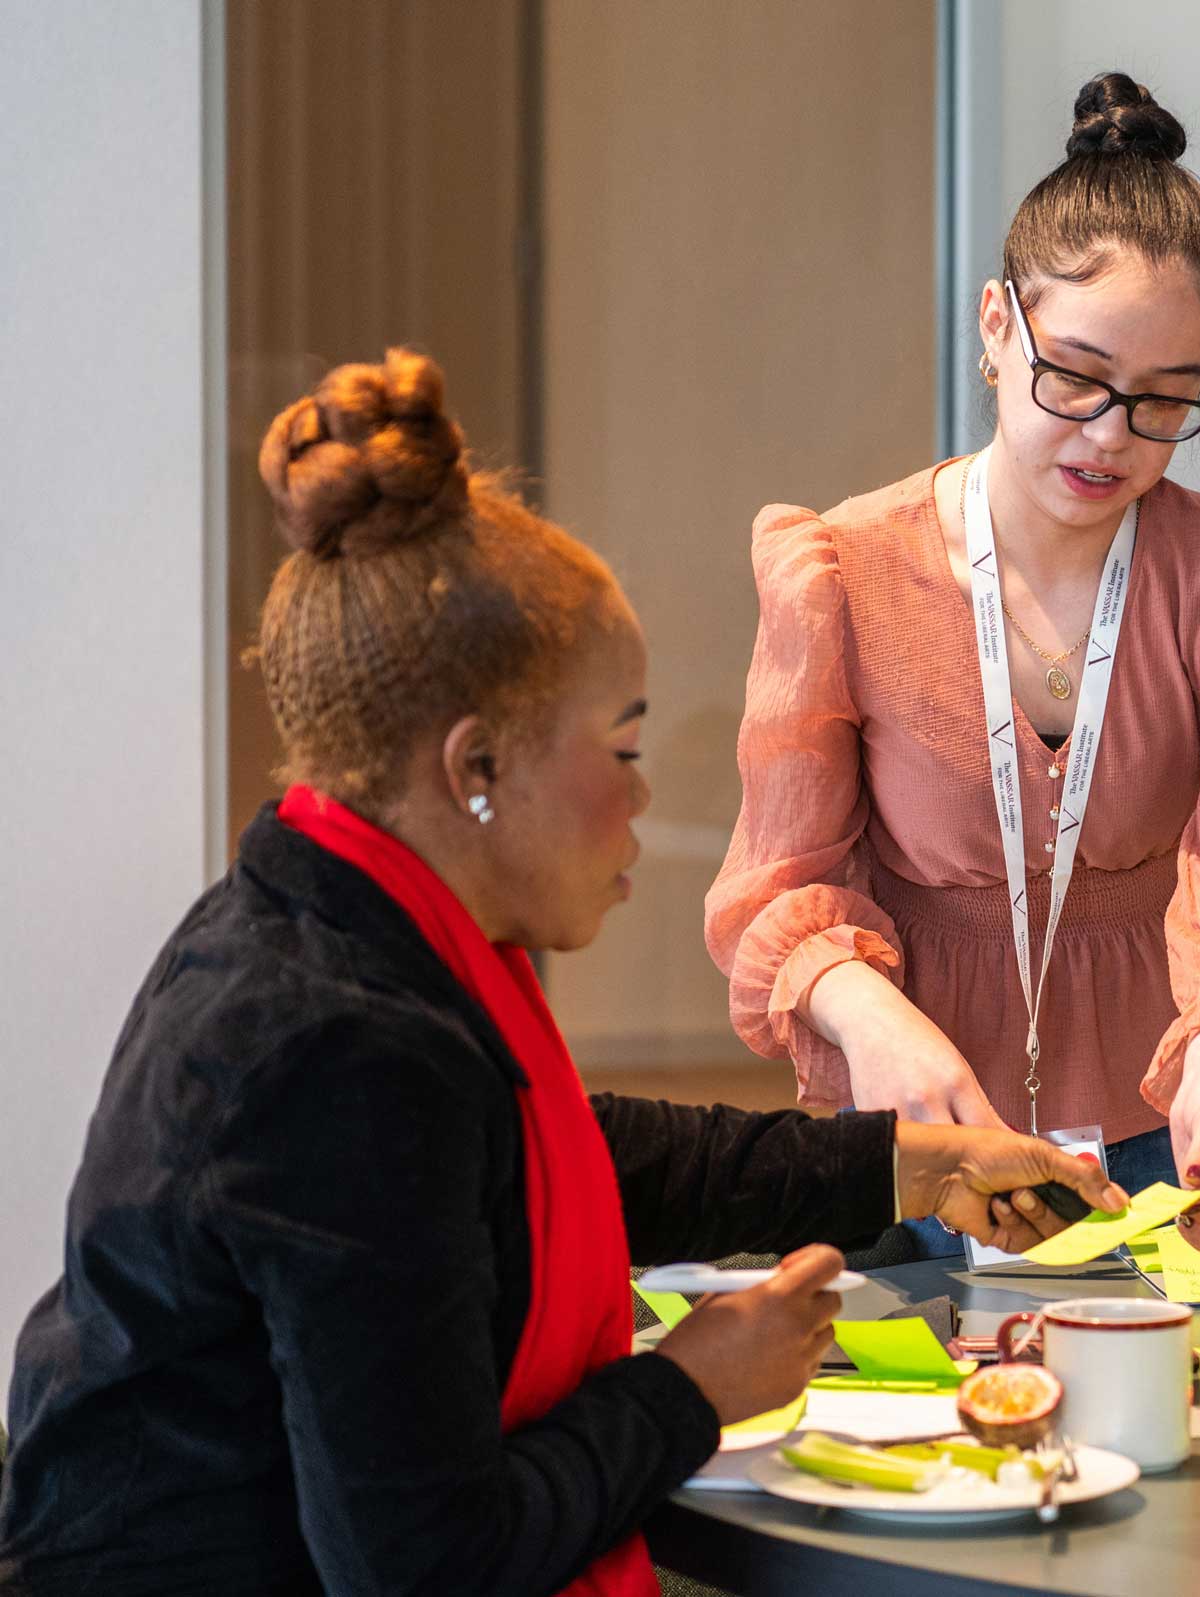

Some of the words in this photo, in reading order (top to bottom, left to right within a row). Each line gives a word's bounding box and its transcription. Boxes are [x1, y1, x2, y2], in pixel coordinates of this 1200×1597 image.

[1107, 559, 1120, 588] Institute
[1102, 587, 1114, 616] VASSAR
[987, 603, 998, 634] VASSAR
[990, 634, 999, 664] Institute
[1077, 723, 1089, 753] Institute
[1003, 761, 1011, 774] The
[1072, 753, 1083, 782] VASSAR
[1005, 774, 1015, 804] VASSAR
[1069, 782, 1078, 796] The
[1008, 804, 1016, 833] Institute
